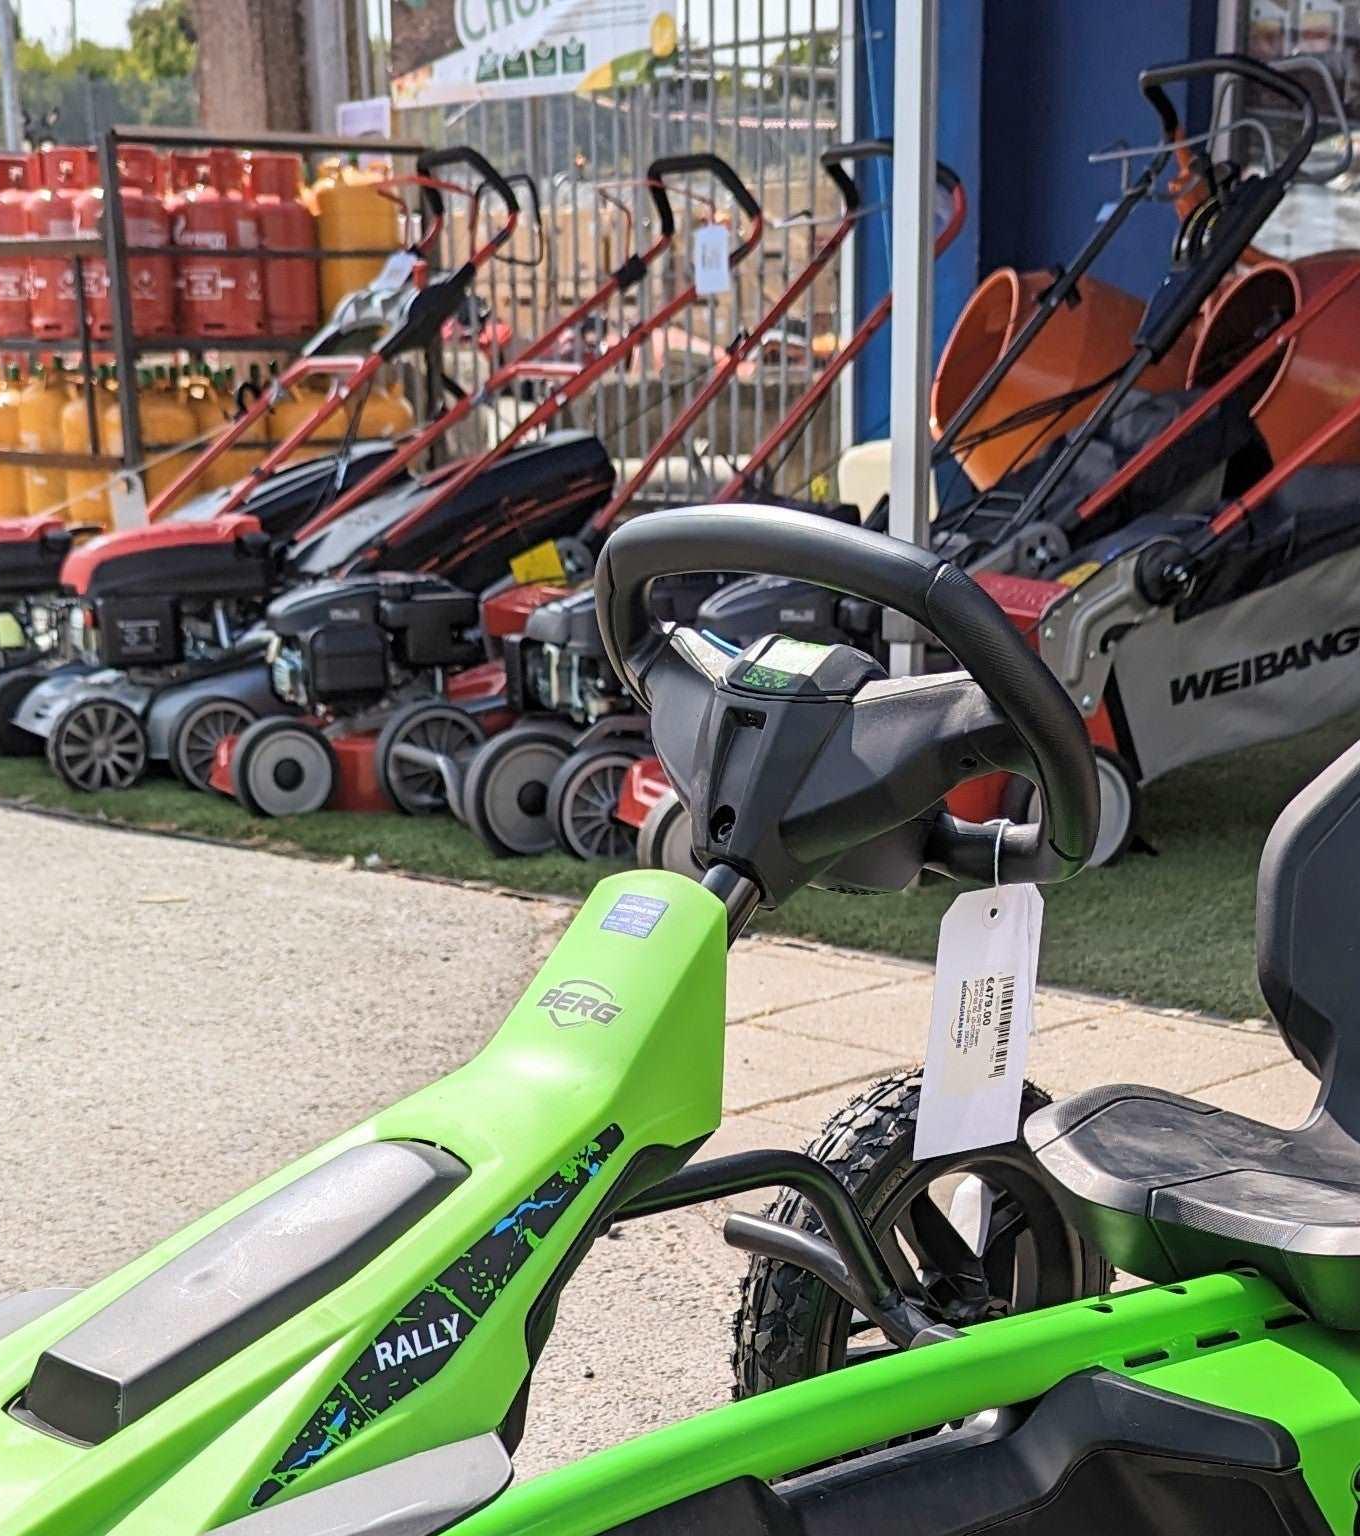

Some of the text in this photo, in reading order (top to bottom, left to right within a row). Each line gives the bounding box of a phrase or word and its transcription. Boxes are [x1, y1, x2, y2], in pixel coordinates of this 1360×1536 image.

[536, 988, 623, 1025] BERG
[958, 980, 968, 1029] MONAGHAN
[982, 976, 995, 1026] €479.00
[375, 1313, 460, 1371] RALLY
